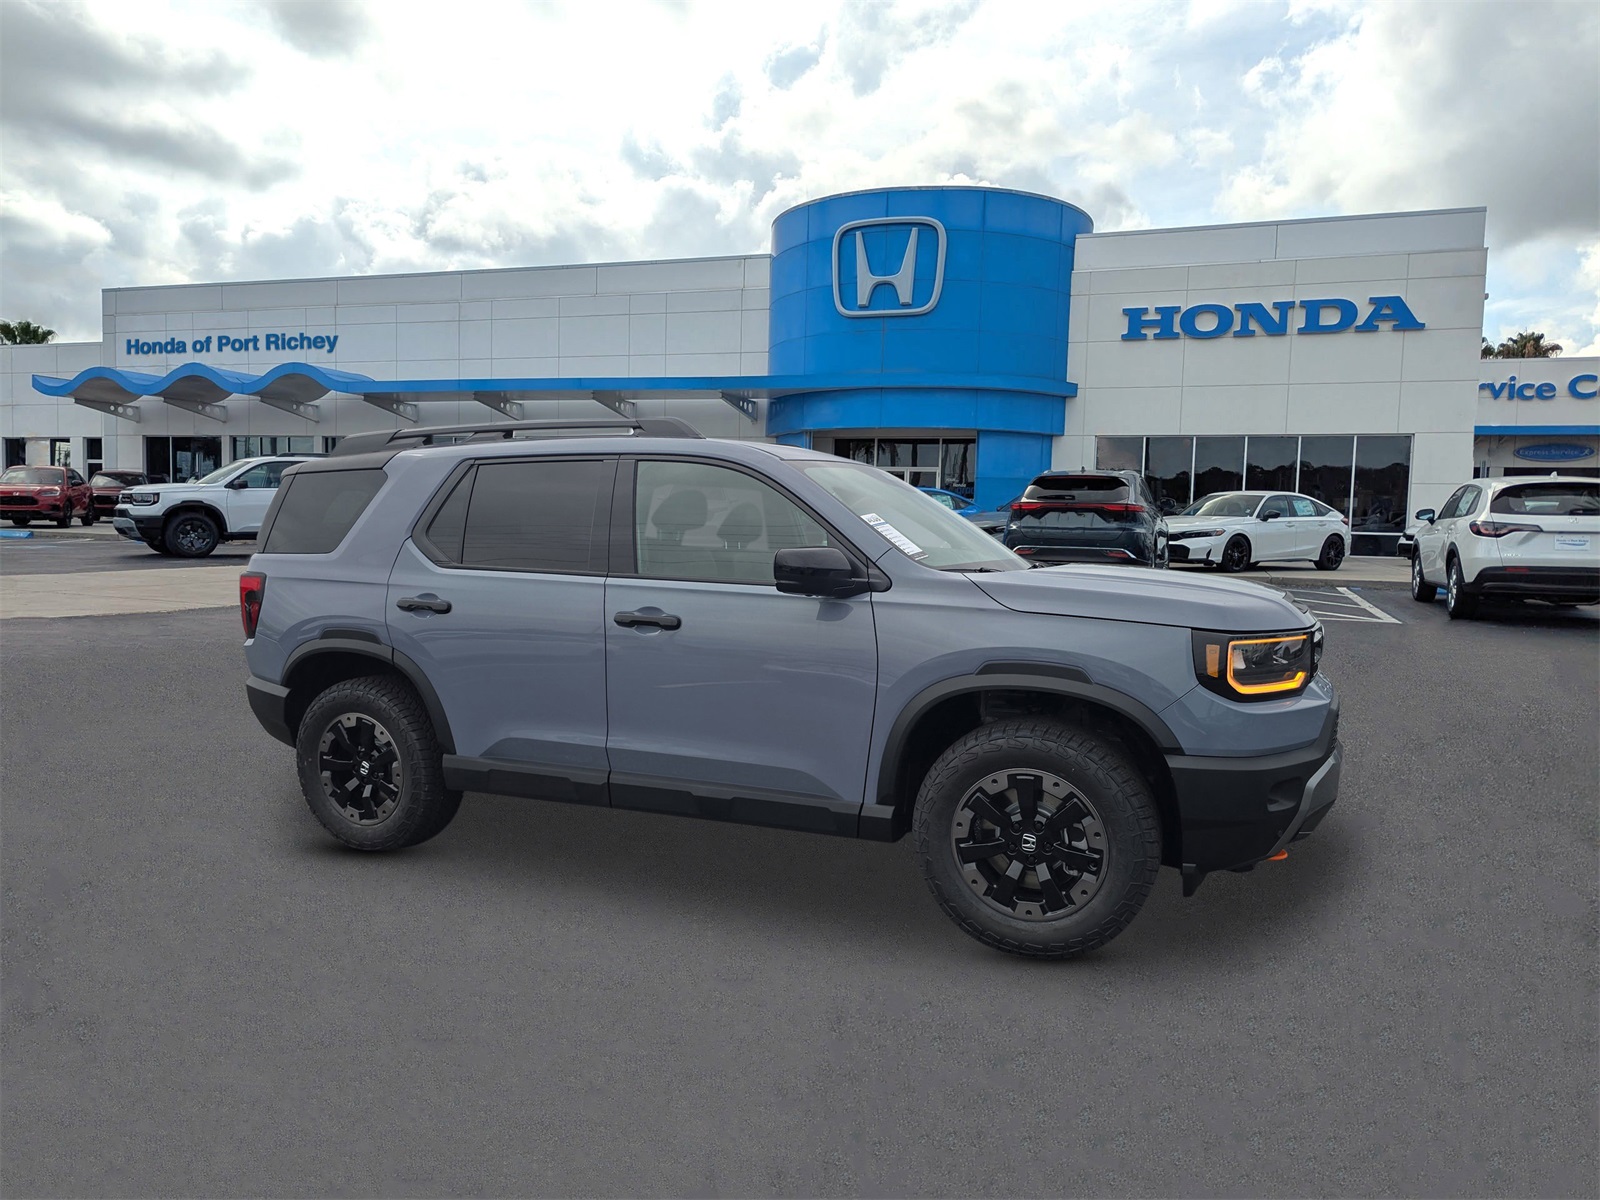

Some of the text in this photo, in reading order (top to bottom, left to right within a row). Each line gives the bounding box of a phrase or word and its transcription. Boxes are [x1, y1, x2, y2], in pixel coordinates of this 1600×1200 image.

[1121, 295, 1426, 341] HONDA
[126, 332, 339, 355] Honda of Port Richey
